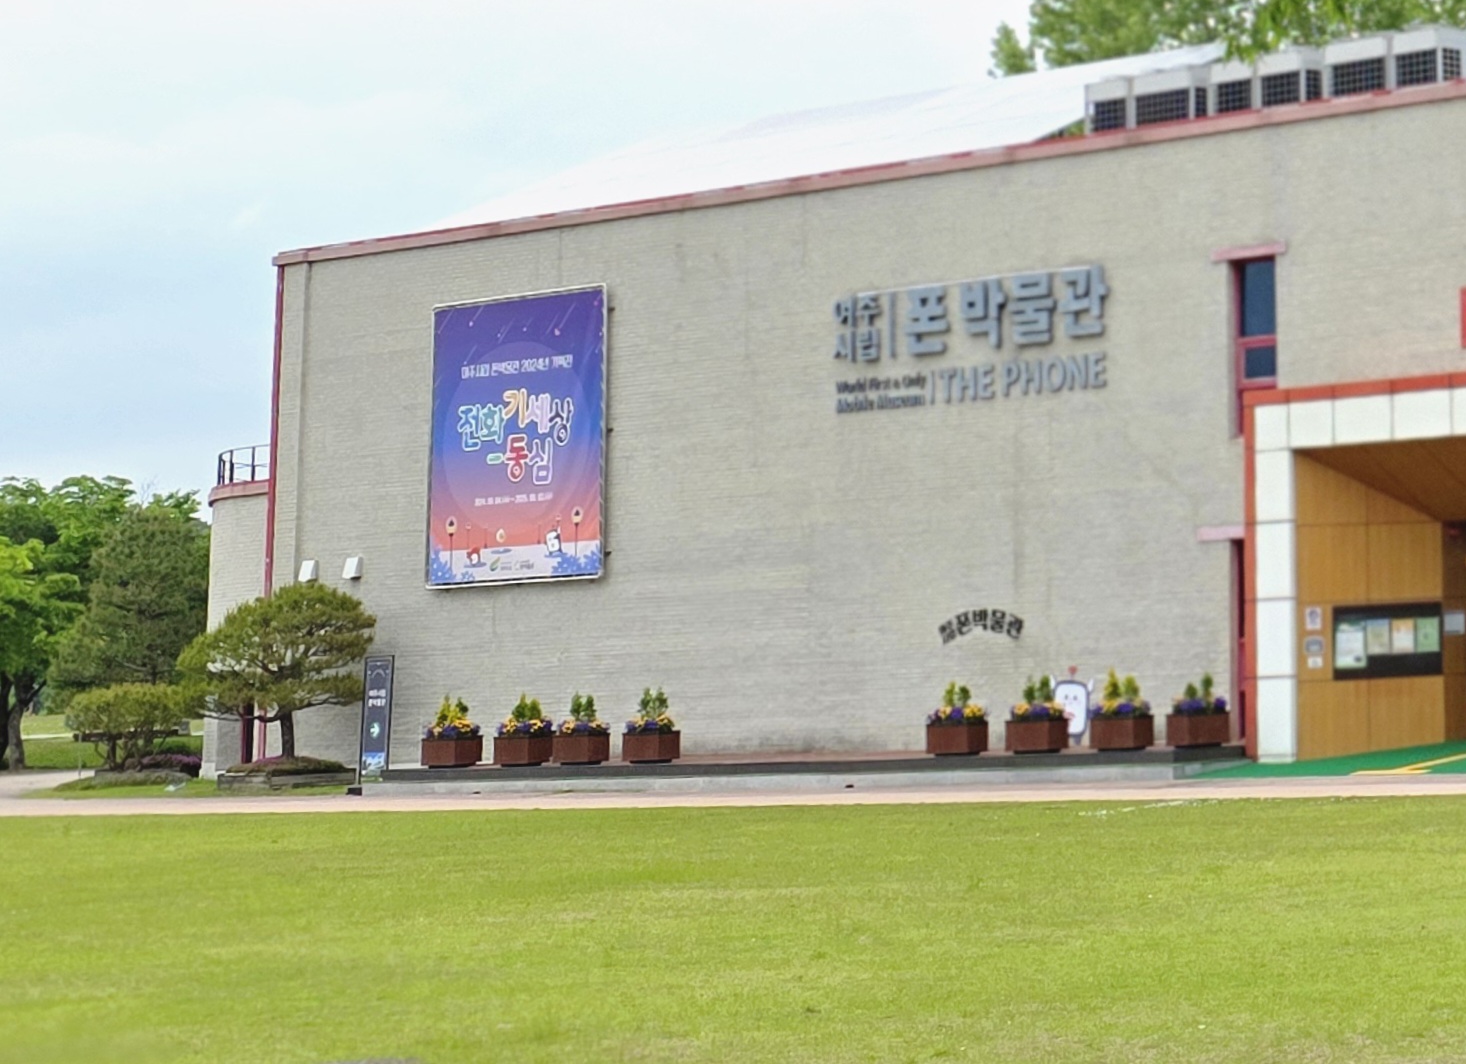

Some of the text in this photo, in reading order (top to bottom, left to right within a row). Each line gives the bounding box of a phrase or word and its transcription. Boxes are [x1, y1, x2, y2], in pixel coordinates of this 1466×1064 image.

[834, 294, 882, 327] 여주
[905, 264, 1109, 357] 폰박물관
[833, 329, 882, 364] 시립
[939, 352, 1107, 404] THE PHONE
